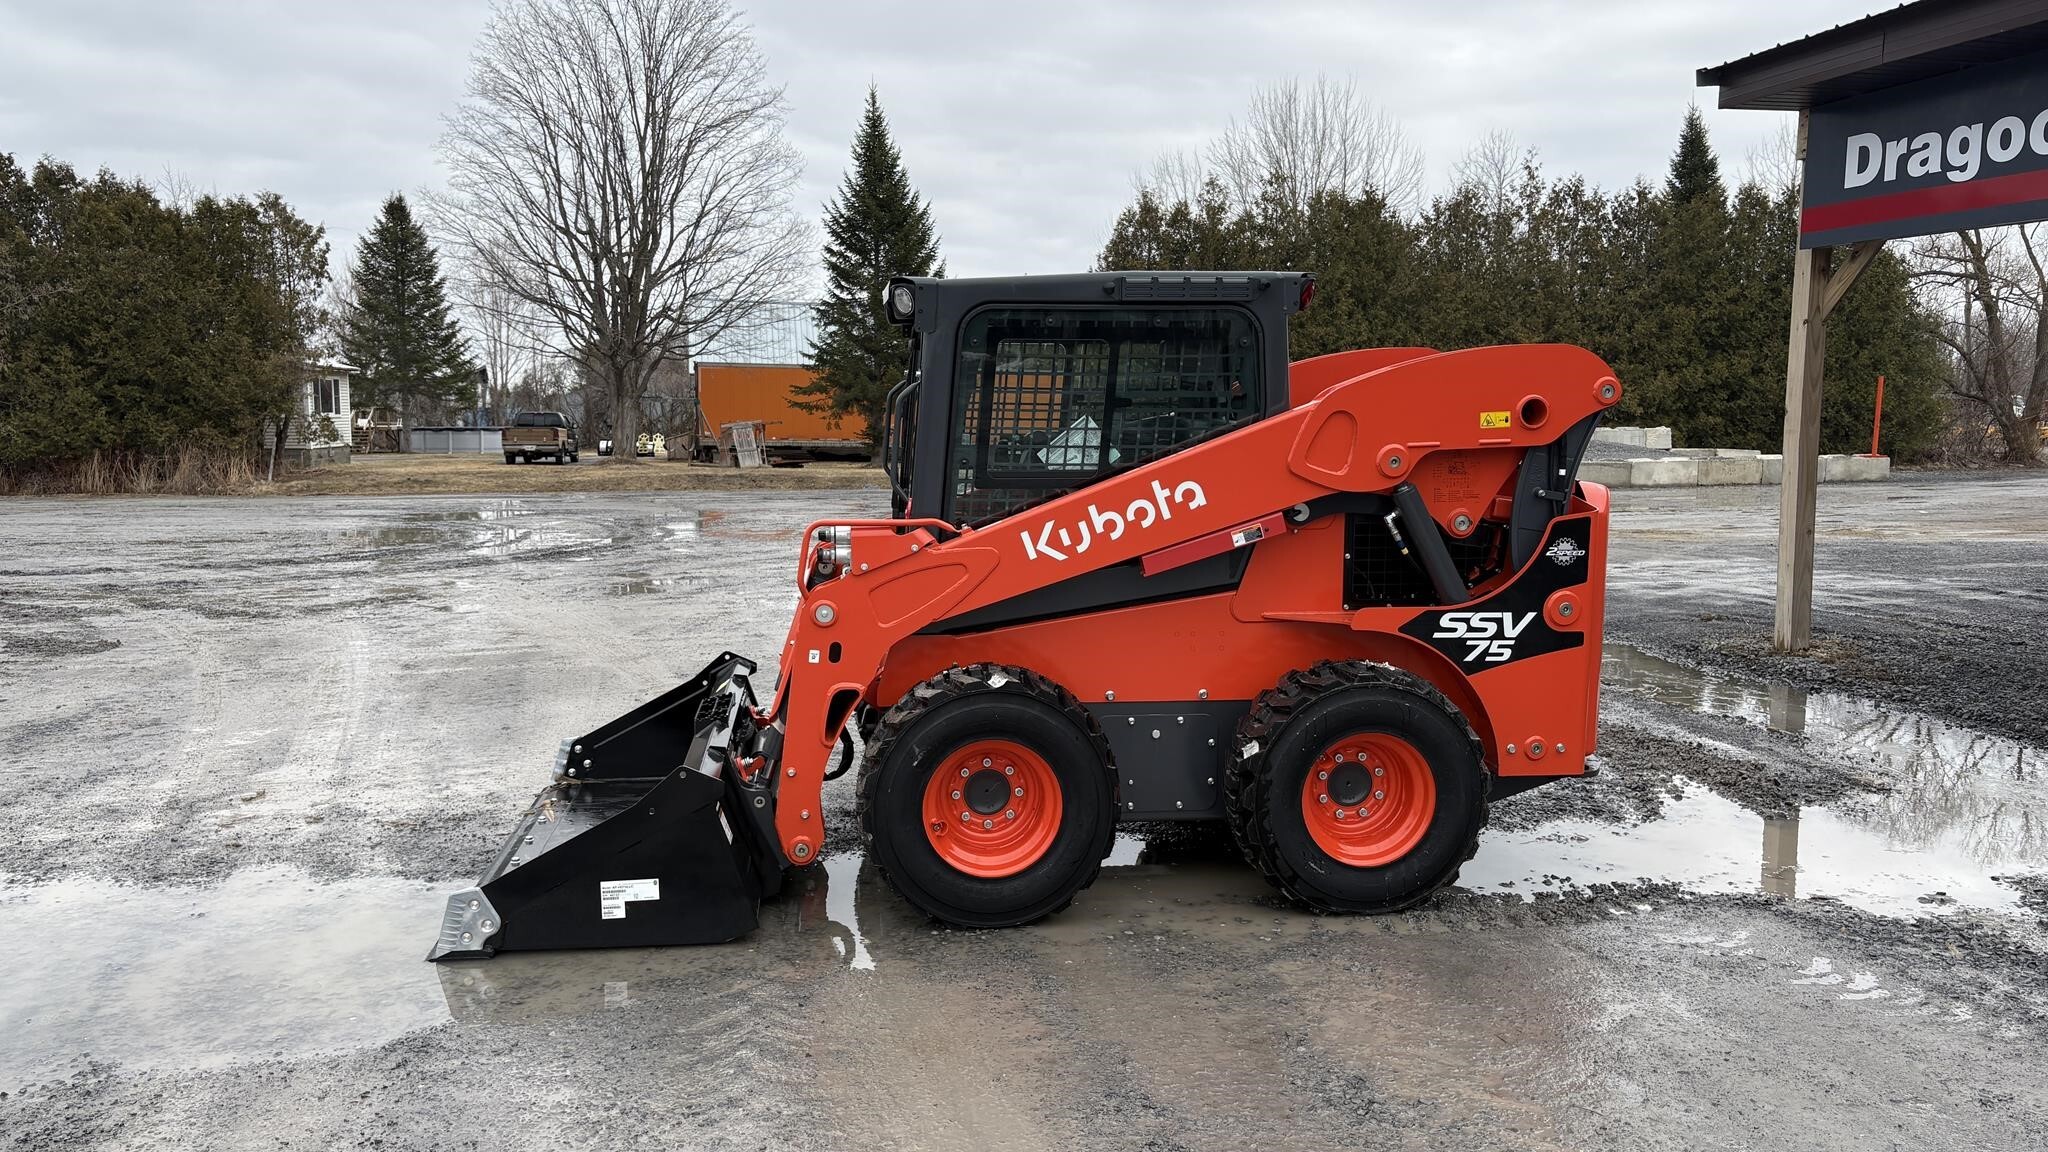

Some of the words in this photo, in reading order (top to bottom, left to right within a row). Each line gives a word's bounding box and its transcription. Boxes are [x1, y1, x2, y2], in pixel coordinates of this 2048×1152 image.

[1020, 480, 1207, 561] Kubota
[1432, 612, 1538, 639] SSV
[1463, 640, 1516, 662] 75
